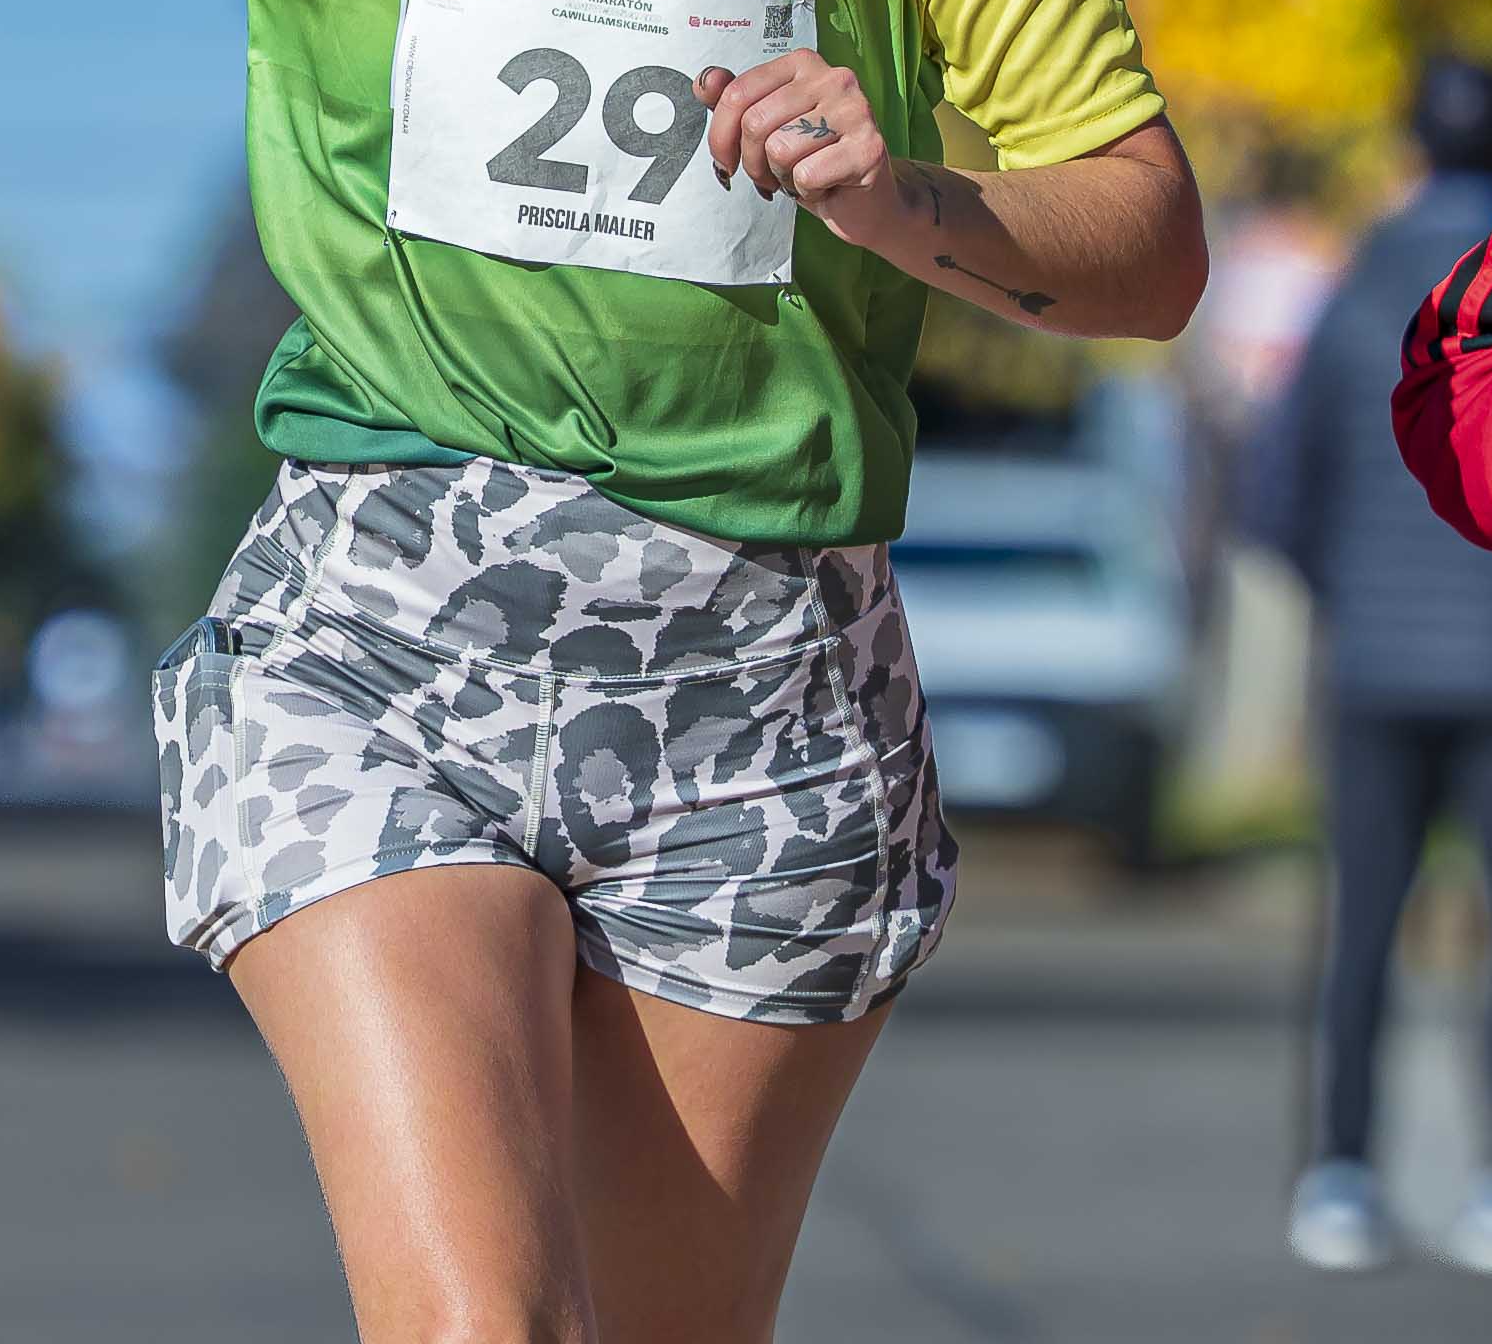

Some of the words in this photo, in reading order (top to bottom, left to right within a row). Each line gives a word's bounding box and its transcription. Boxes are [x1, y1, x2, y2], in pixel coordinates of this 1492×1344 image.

[551, 7, 669, 35] CAWILLIAMSKEMMIS
[702, 17, 712, 26] la
[713, 17, 751, 28] segunda
[486, 47, 708, 205] 29
[517, 204, 590, 232] PRISCILA
[594, 213, 655, 241] MALIER
